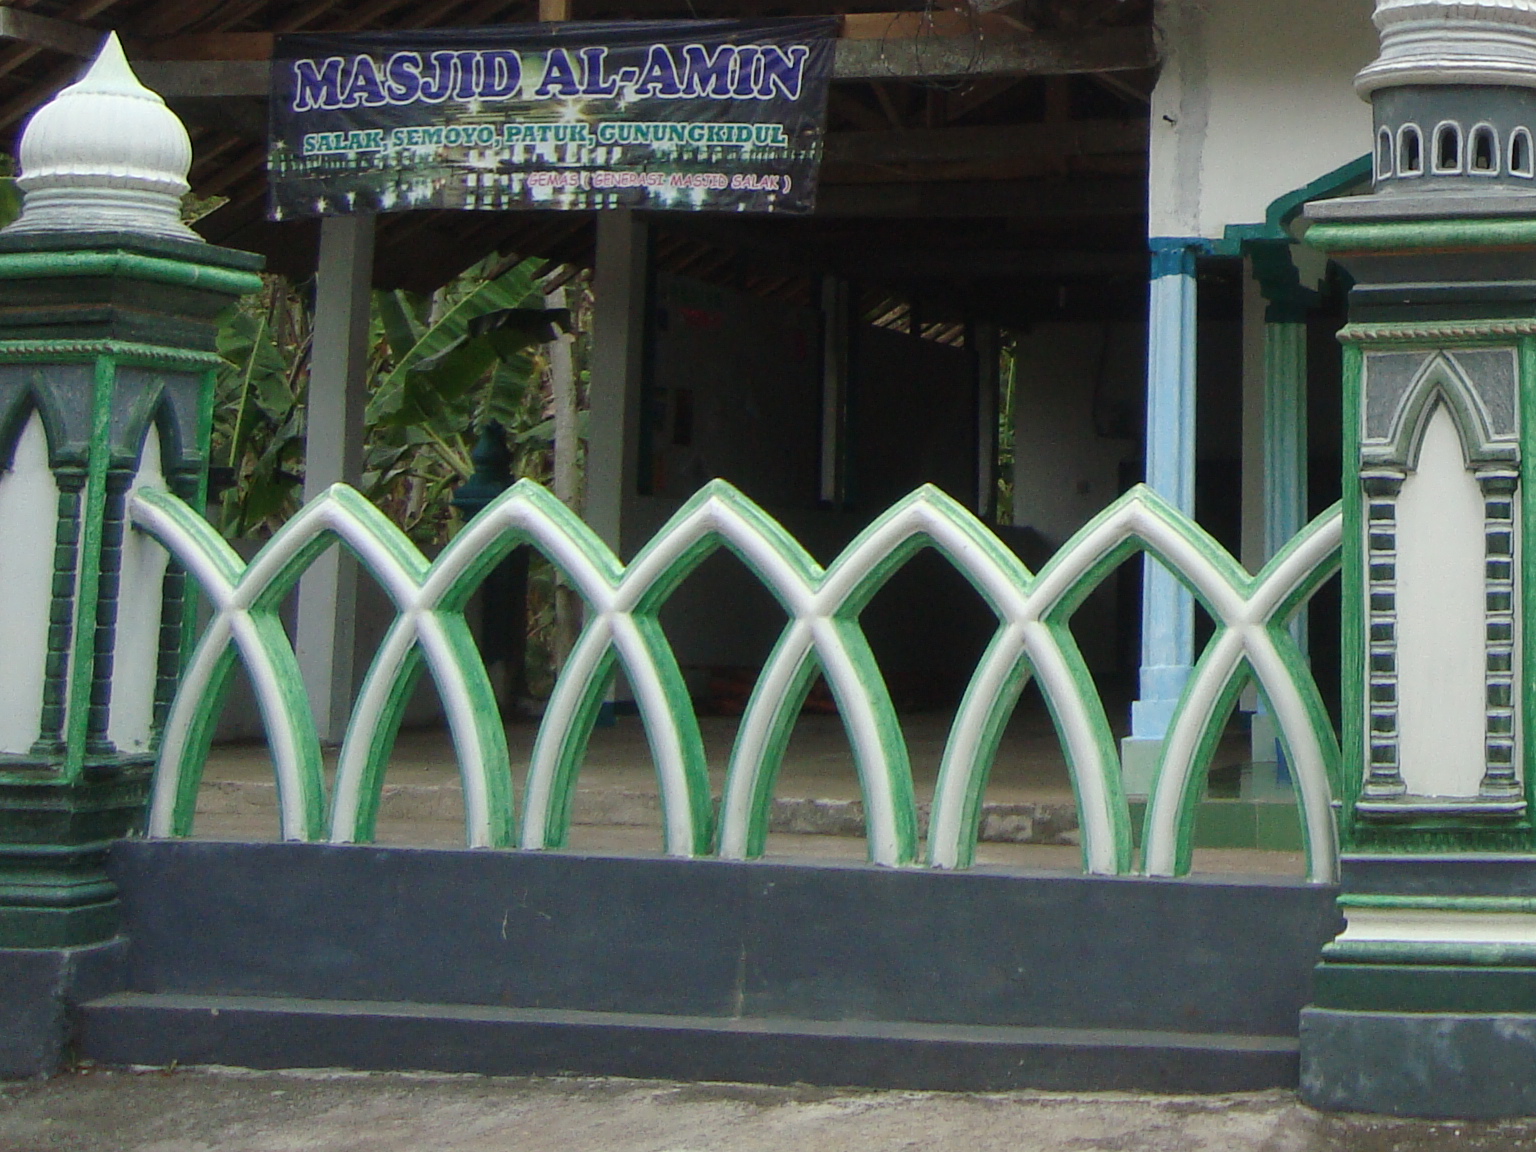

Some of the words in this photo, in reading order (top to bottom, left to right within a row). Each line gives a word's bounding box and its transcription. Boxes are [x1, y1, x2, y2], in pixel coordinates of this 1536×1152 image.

[293, 50, 522, 112] MASJID
[534, 44, 810, 99] AL-AMIN
[303, 130, 390, 156] SALAK,
[391, 125, 502, 149] SEMOYO,
[503, 123, 594, 148] PATUK,
[597, 122, 788, 147] GUNUNGKIDUL
[527, 172, 580, 189] GEMAS
[669, 173, 728, 190] MASJID
